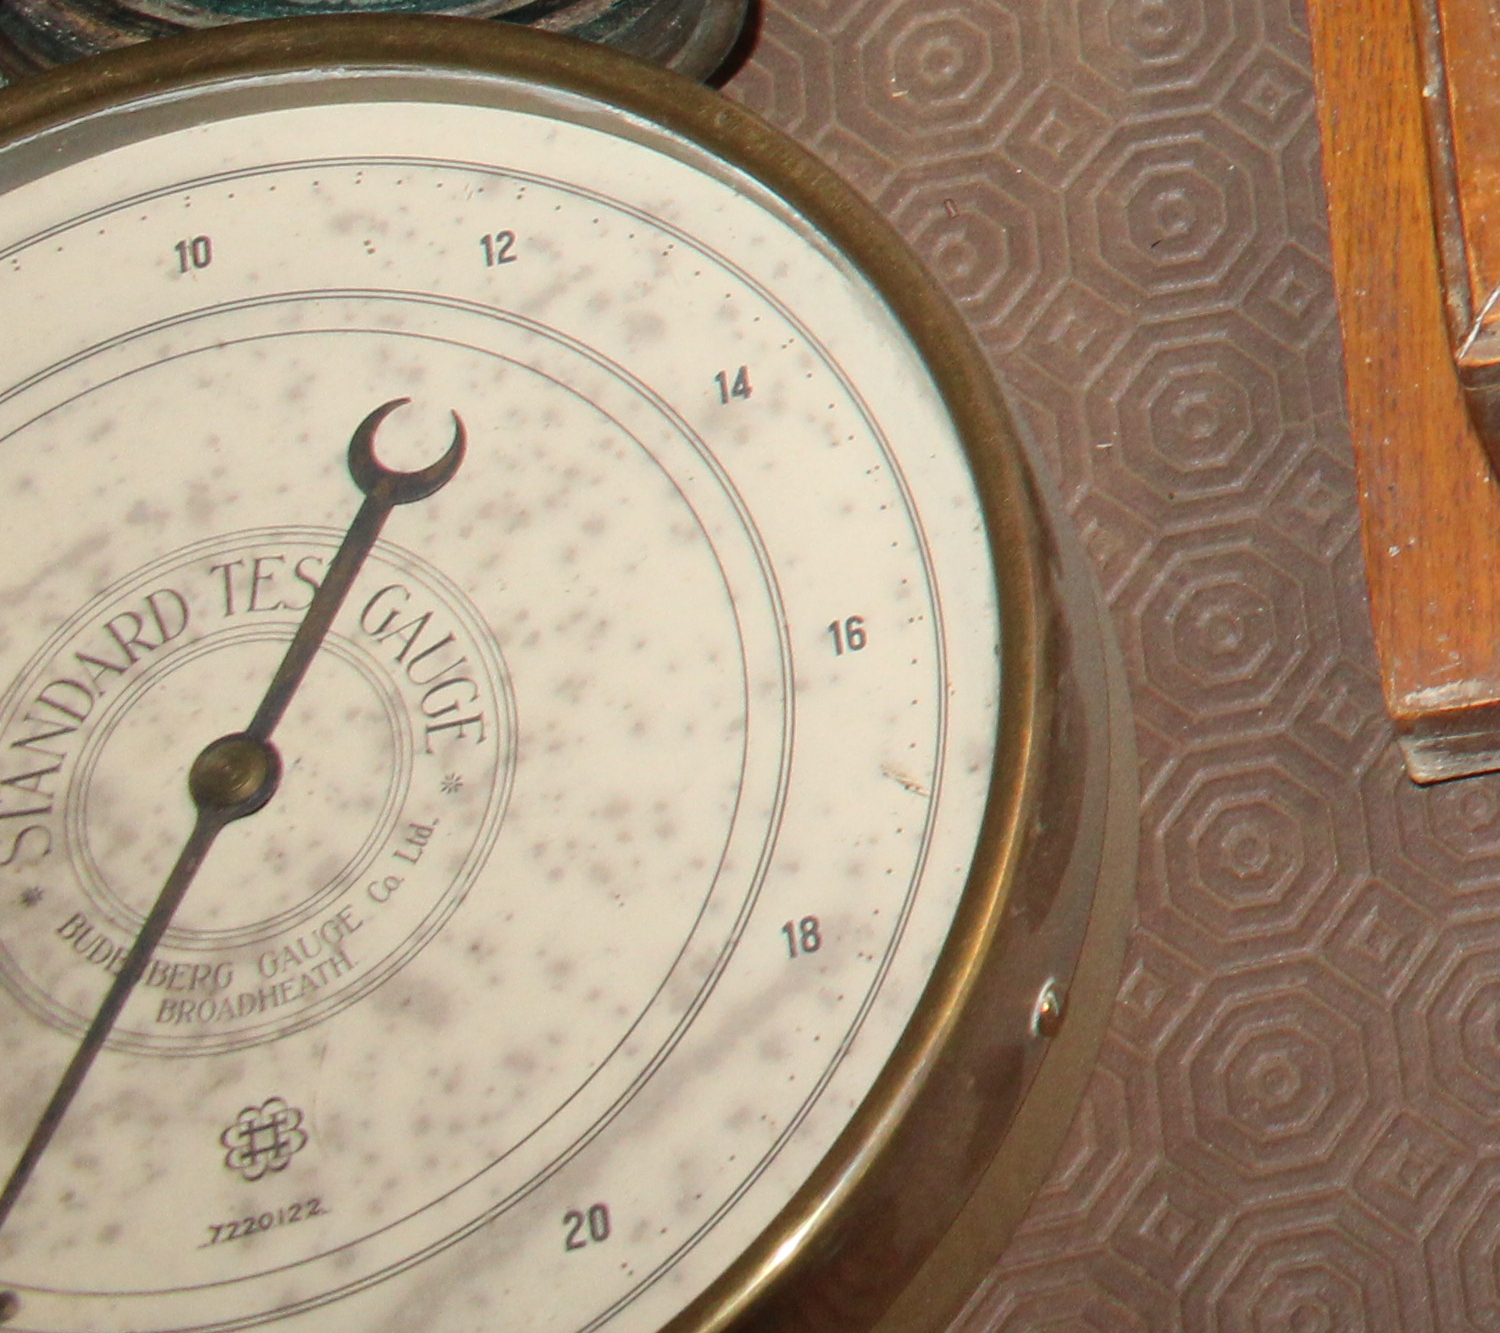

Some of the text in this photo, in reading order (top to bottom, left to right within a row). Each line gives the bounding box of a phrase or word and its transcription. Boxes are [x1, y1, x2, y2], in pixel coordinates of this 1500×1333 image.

[174, 234, 214, 274] 10
[480, 230, 518, 268] 12
[714, 365, 754, 405] 14
[209, 554, 336, 618] TES
[359, 583, 487, 755] GAUGE
[827, 614, 868, 657] 16
[257, 904, 365, 979] GAUGE
[781, 914, 823, 959] 18
[562, 1202, 612, 1253] 20
